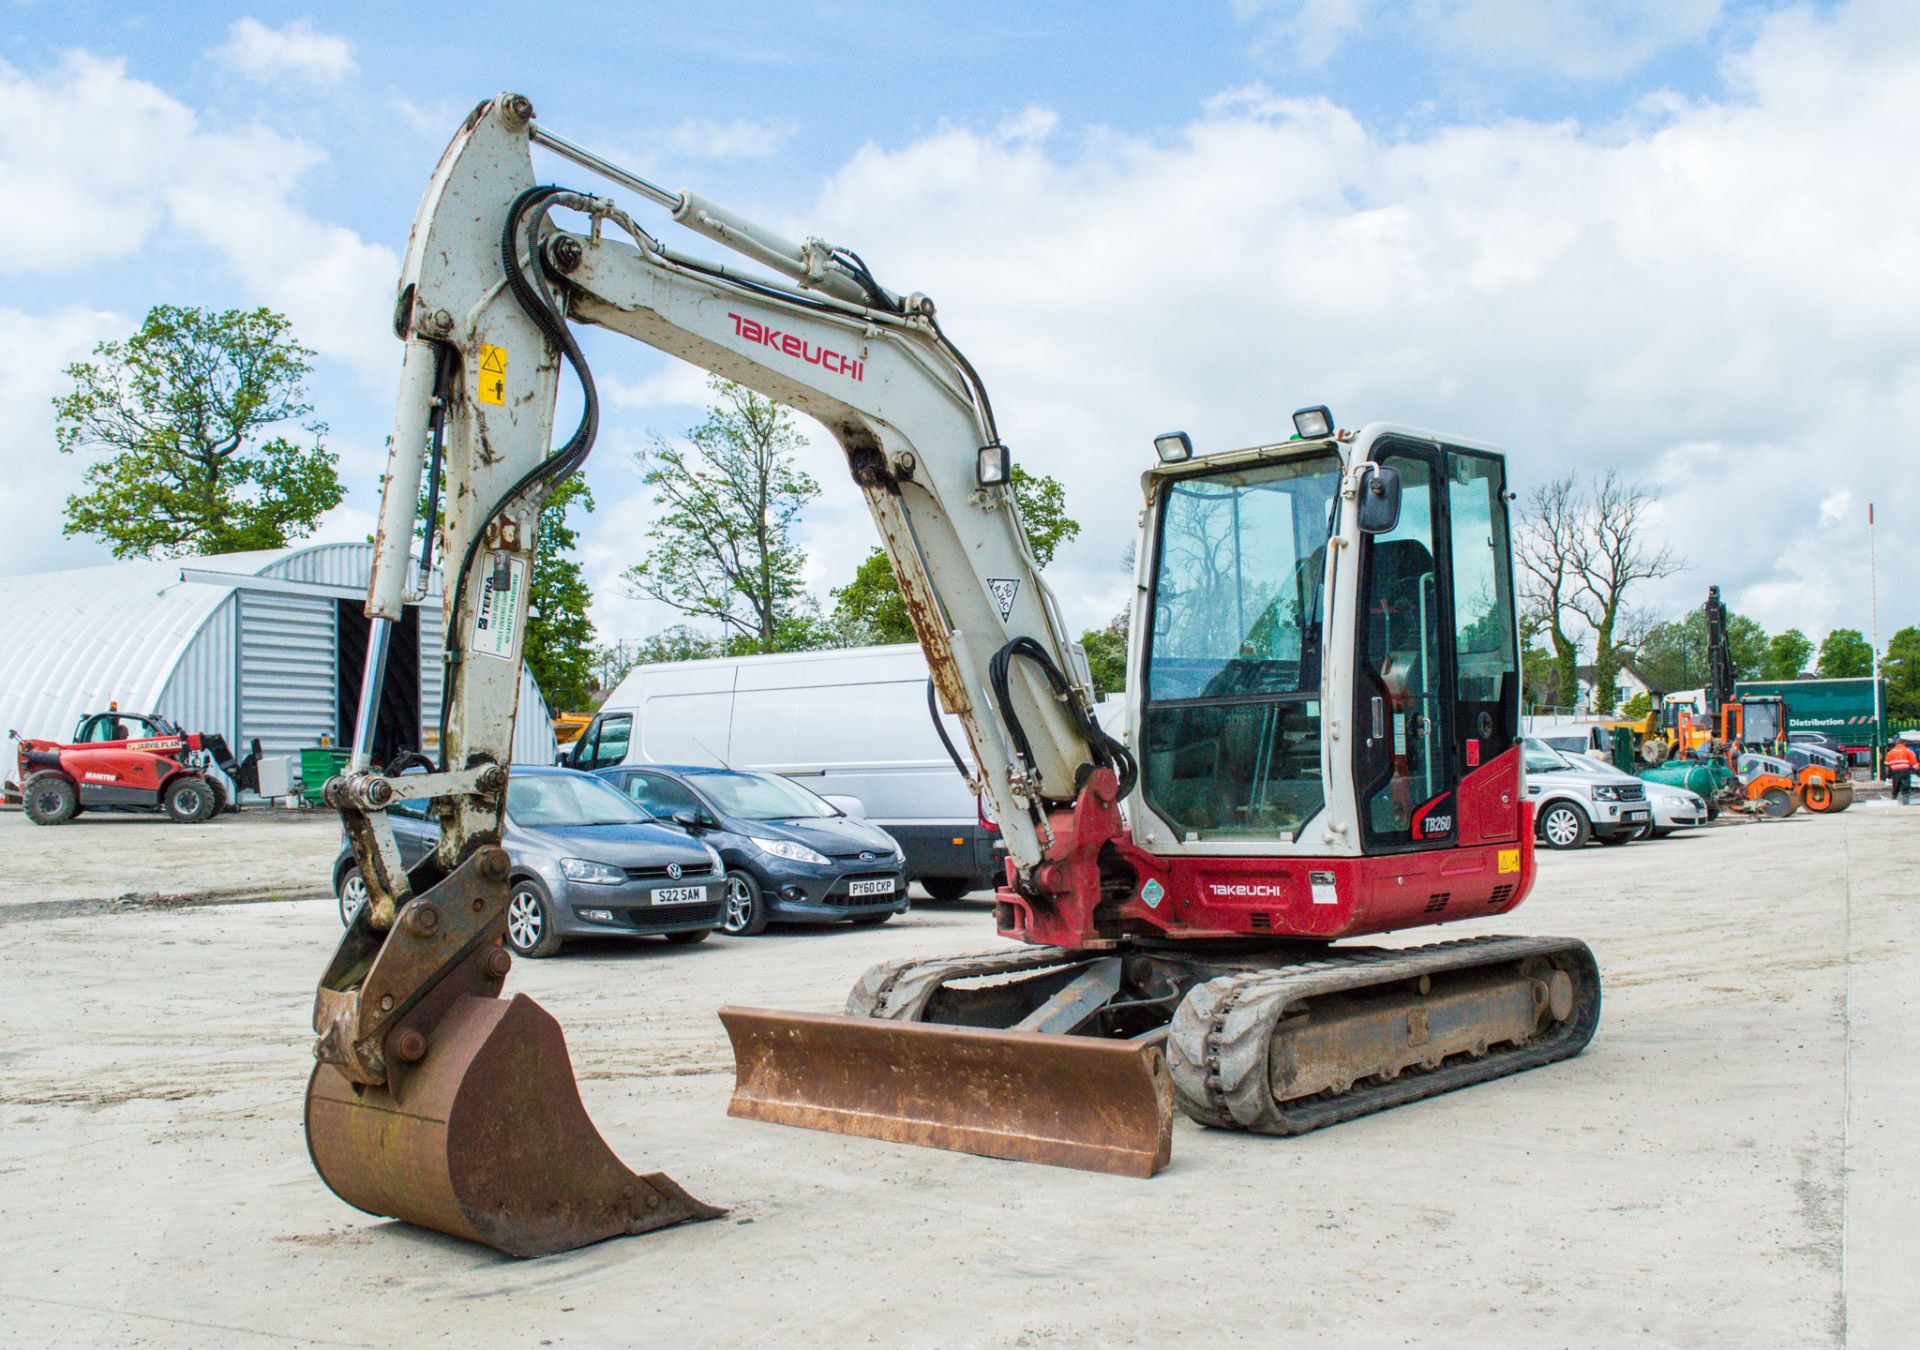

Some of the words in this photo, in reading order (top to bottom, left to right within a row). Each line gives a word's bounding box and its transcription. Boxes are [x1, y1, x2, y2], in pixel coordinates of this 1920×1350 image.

[728, 312, 864, 382] TAKEUCHI
[482, 576, 494, 615] TEFRA
[1789, 718, 1845, 727] Distribution
[161, 740, 180, 748] PLAN
[1425, 816, 1451, 832] TB260
[853, 882, 875, 894] PY60
[876, 881, 891, 892] CKP
[1209, 884, 1281, 896] TAKEUCHI
[659, 890, 679, 902] S22
[681, 889, 699, 901] SAM
